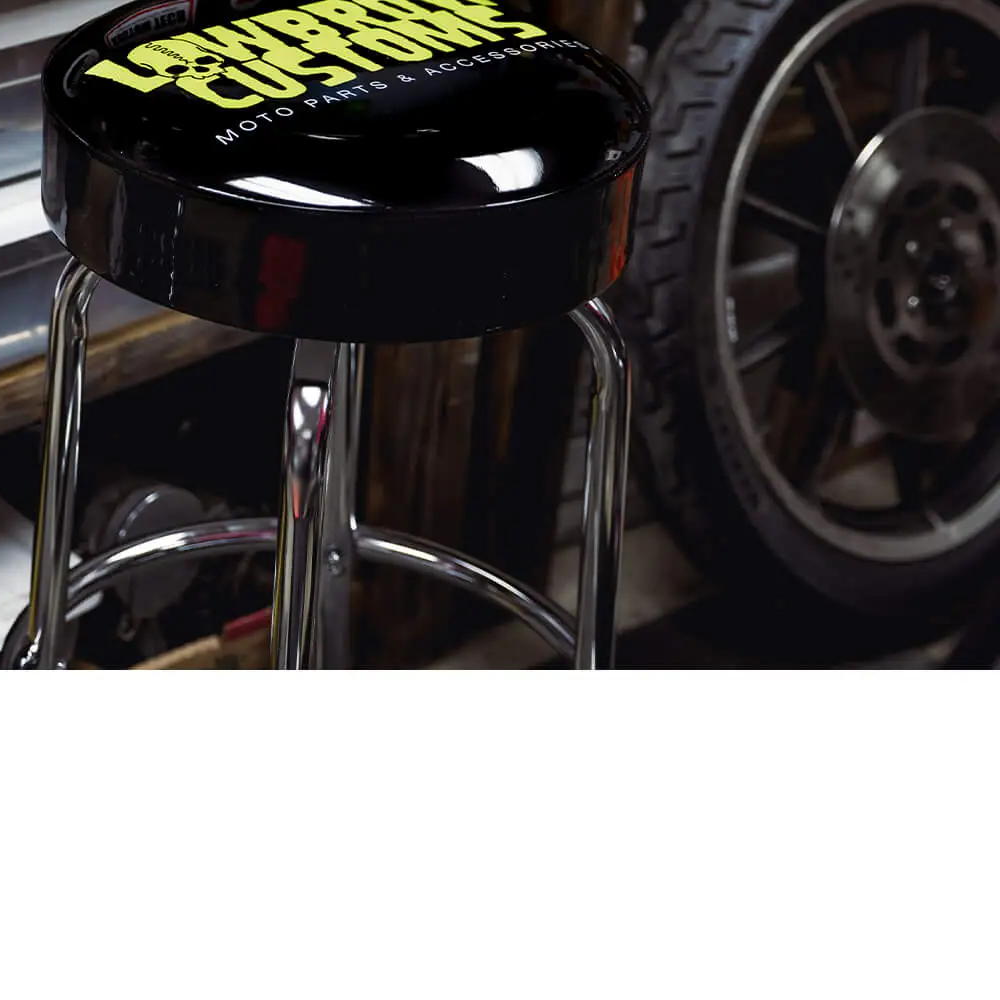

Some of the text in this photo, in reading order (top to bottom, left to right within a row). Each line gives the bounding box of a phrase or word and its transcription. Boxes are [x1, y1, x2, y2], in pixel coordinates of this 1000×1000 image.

[175, 5, 548, 110] CUSTOMS
[215, 105, 295, 146] MOTO
[303, 77, 389, 109] PARTS
[399, 72, 416, 83] &
